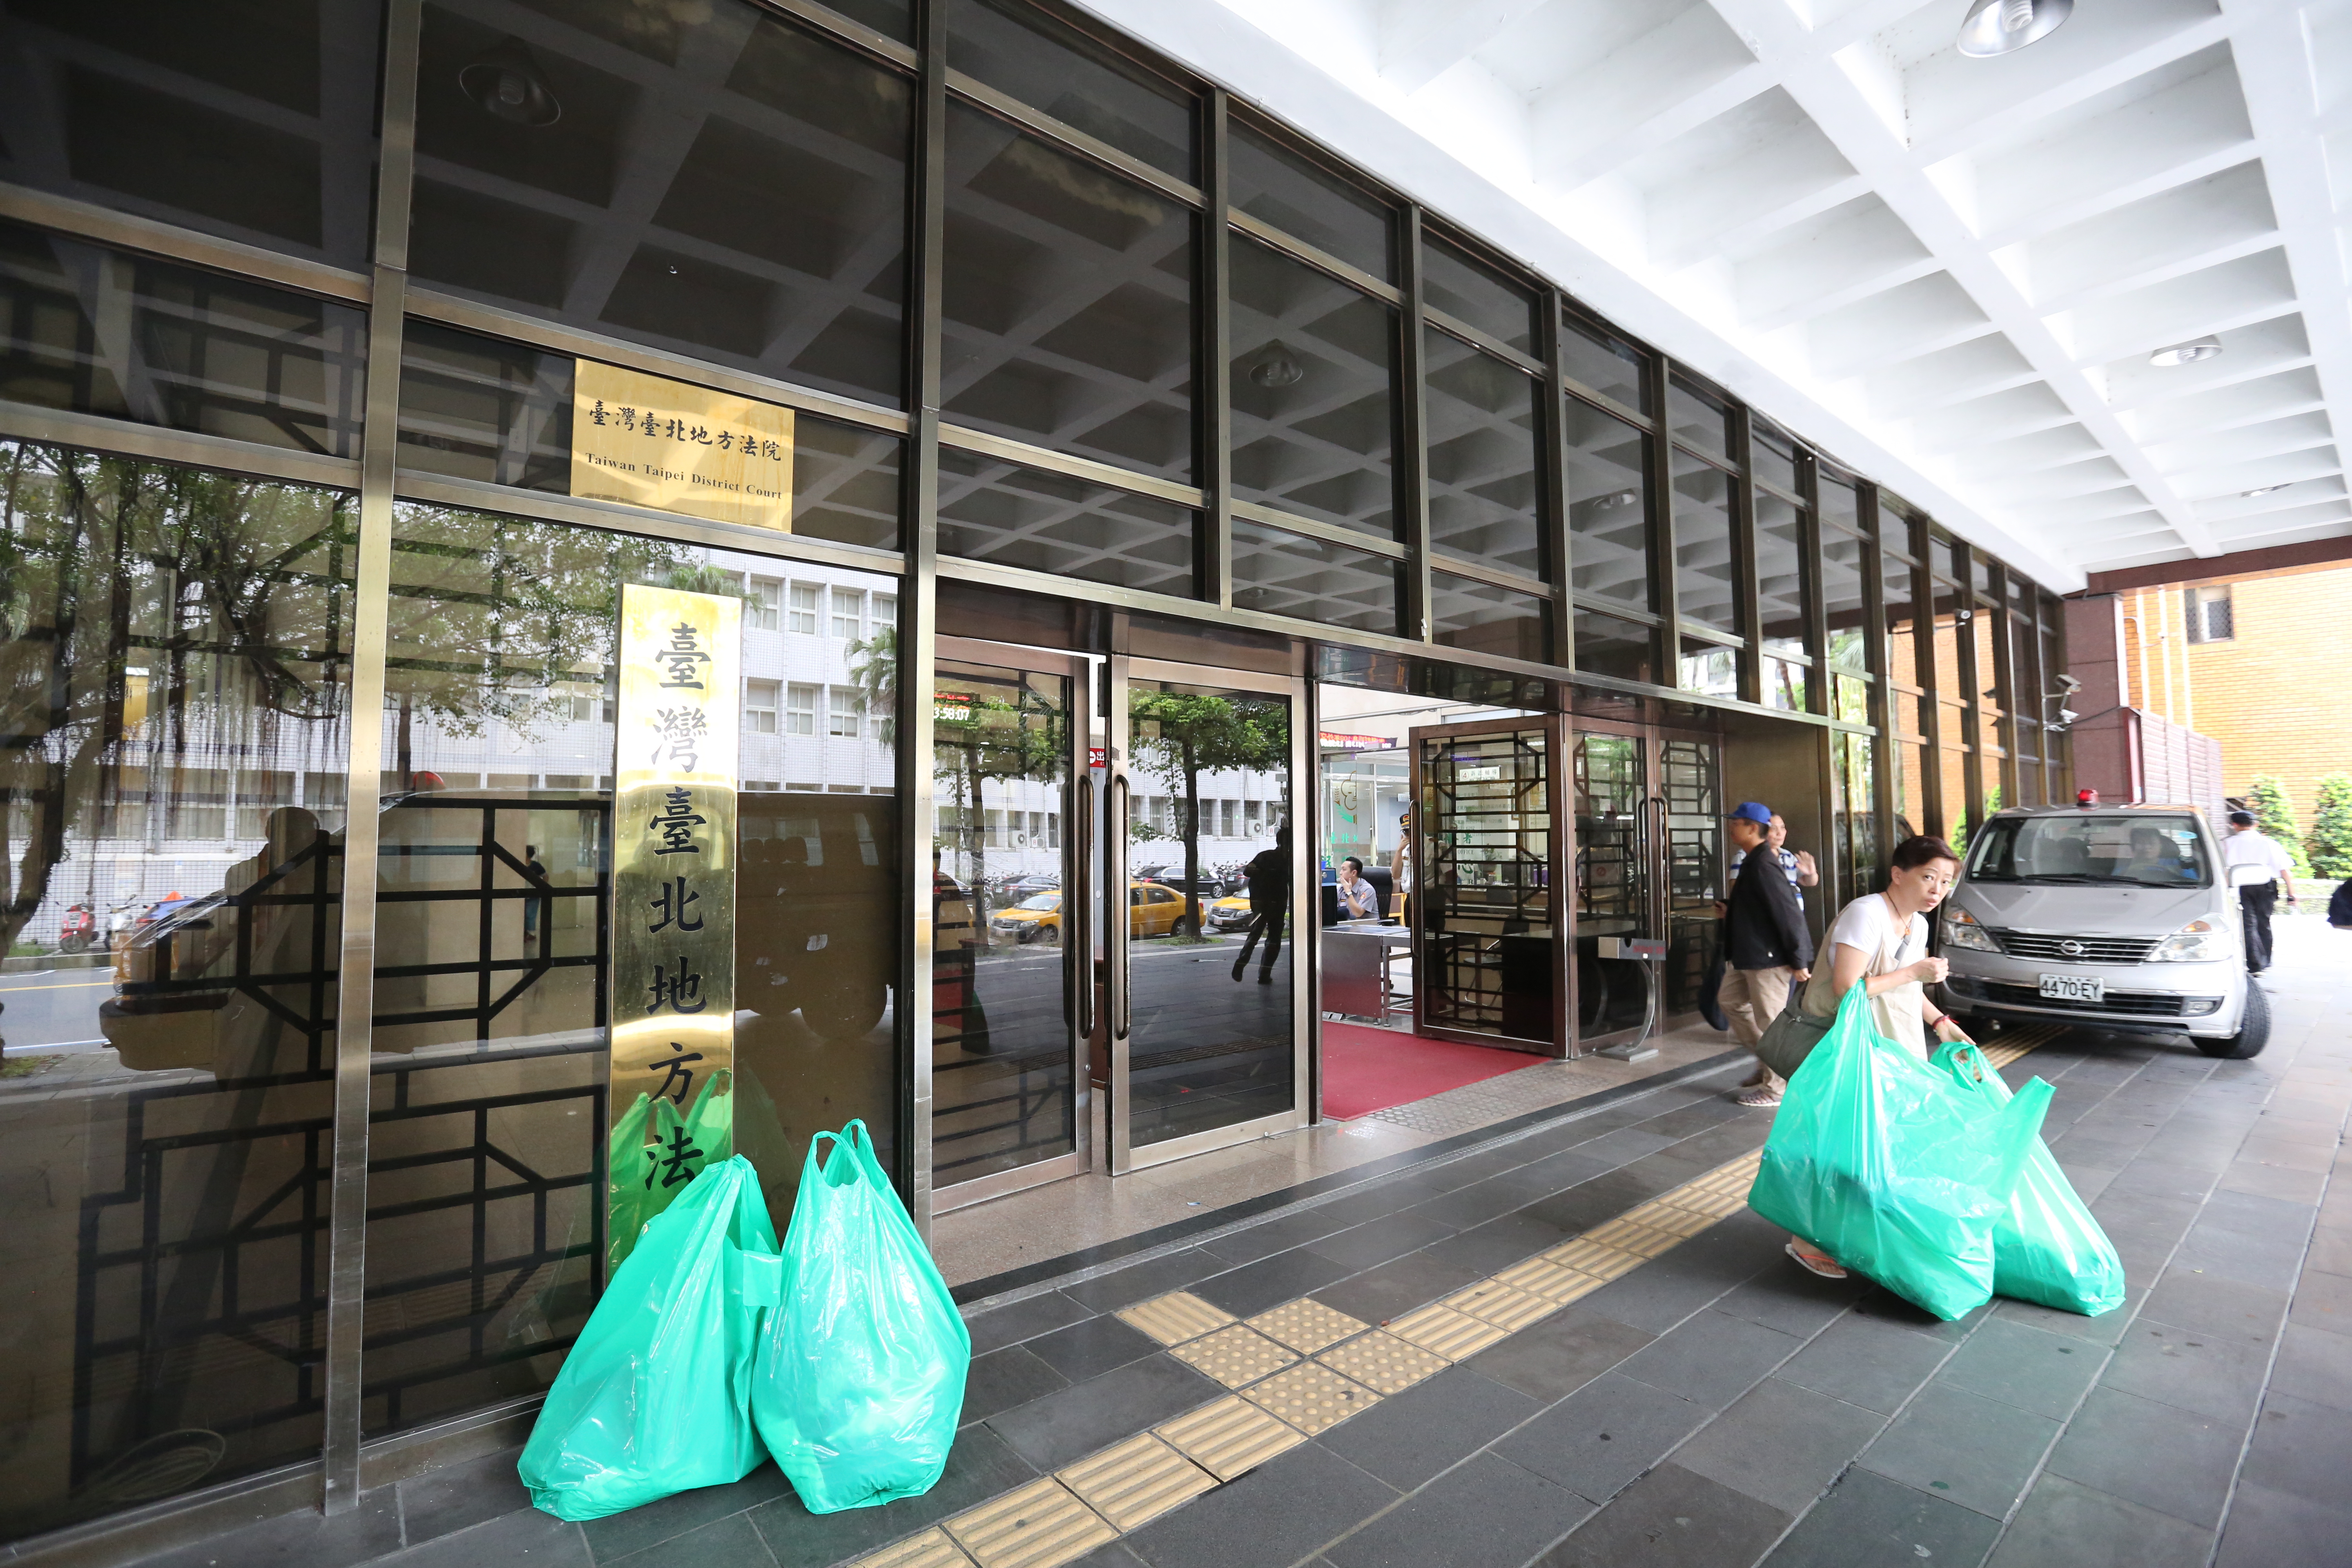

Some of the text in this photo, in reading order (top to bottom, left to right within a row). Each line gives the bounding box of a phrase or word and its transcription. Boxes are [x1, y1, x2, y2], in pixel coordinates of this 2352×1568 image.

[589, 400, 781, 461] 臺灣臺北地方法院
[586, 452, 782, 499] Taiwan Taipei District Court
[2042, 980, 2100, 998] 4470-EY
